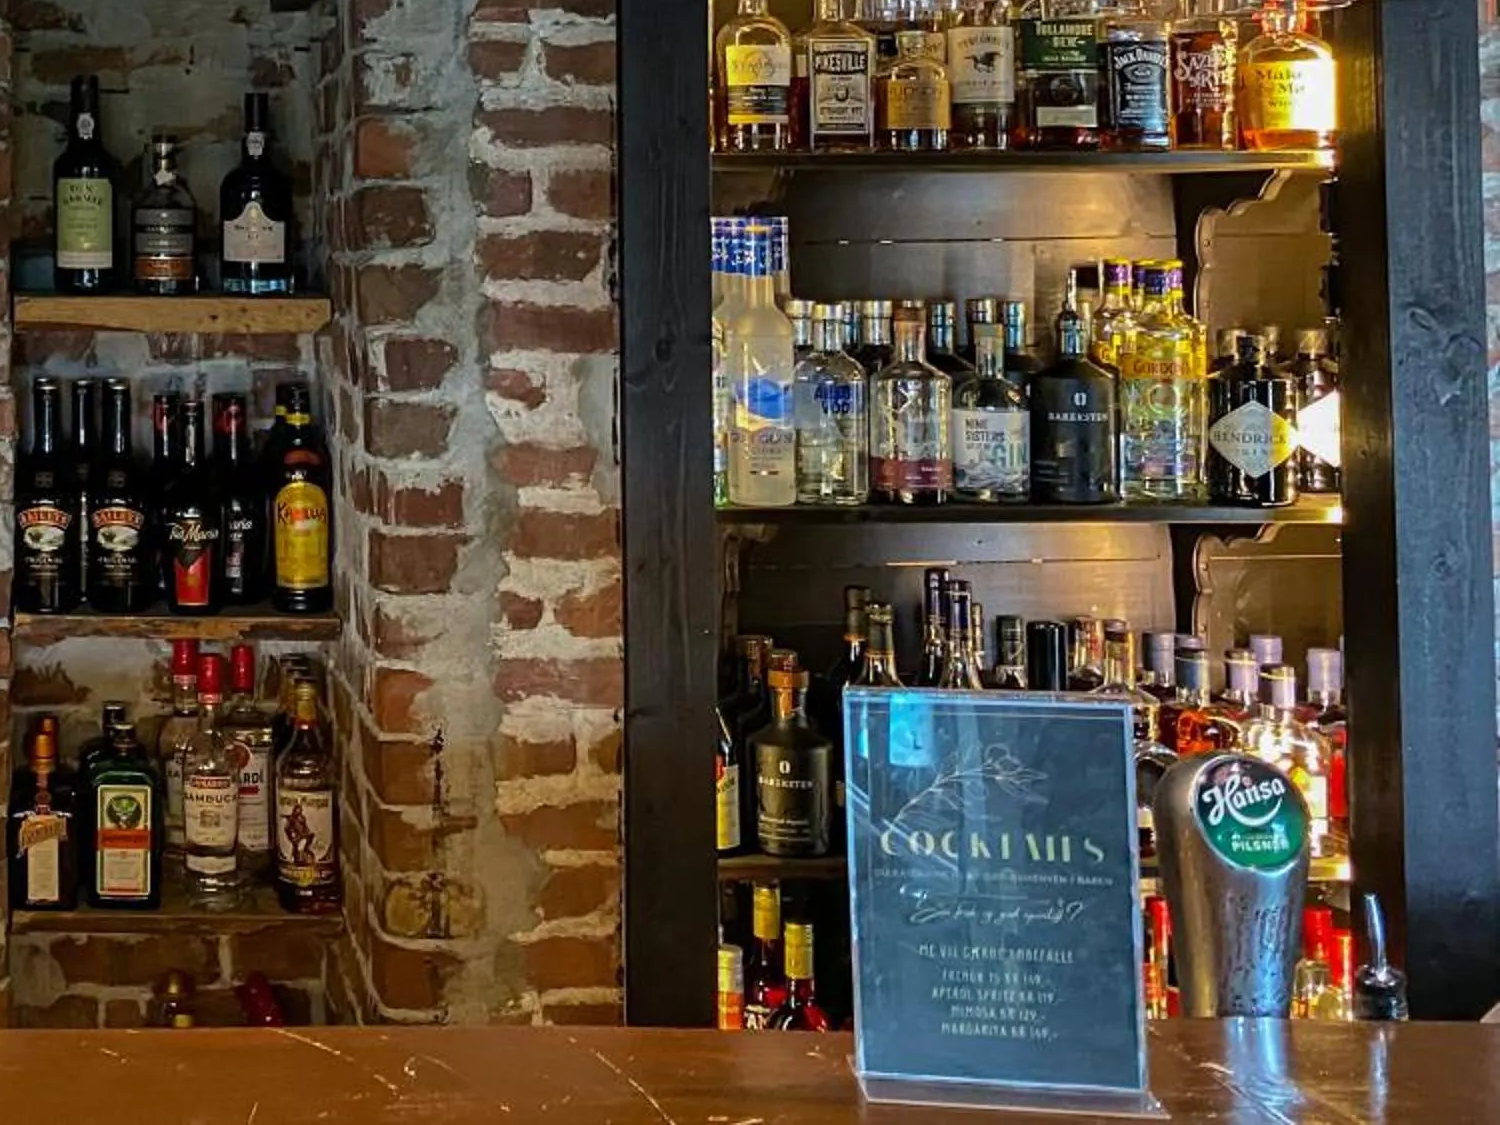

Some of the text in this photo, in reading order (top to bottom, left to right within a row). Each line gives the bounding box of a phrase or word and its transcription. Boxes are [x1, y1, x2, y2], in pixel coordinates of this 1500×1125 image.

[992, 442, 1028, 467] GIN
[1201, 773, 1286, 827] Hansa
[1231, 838, 1289, 853] PILSNER
